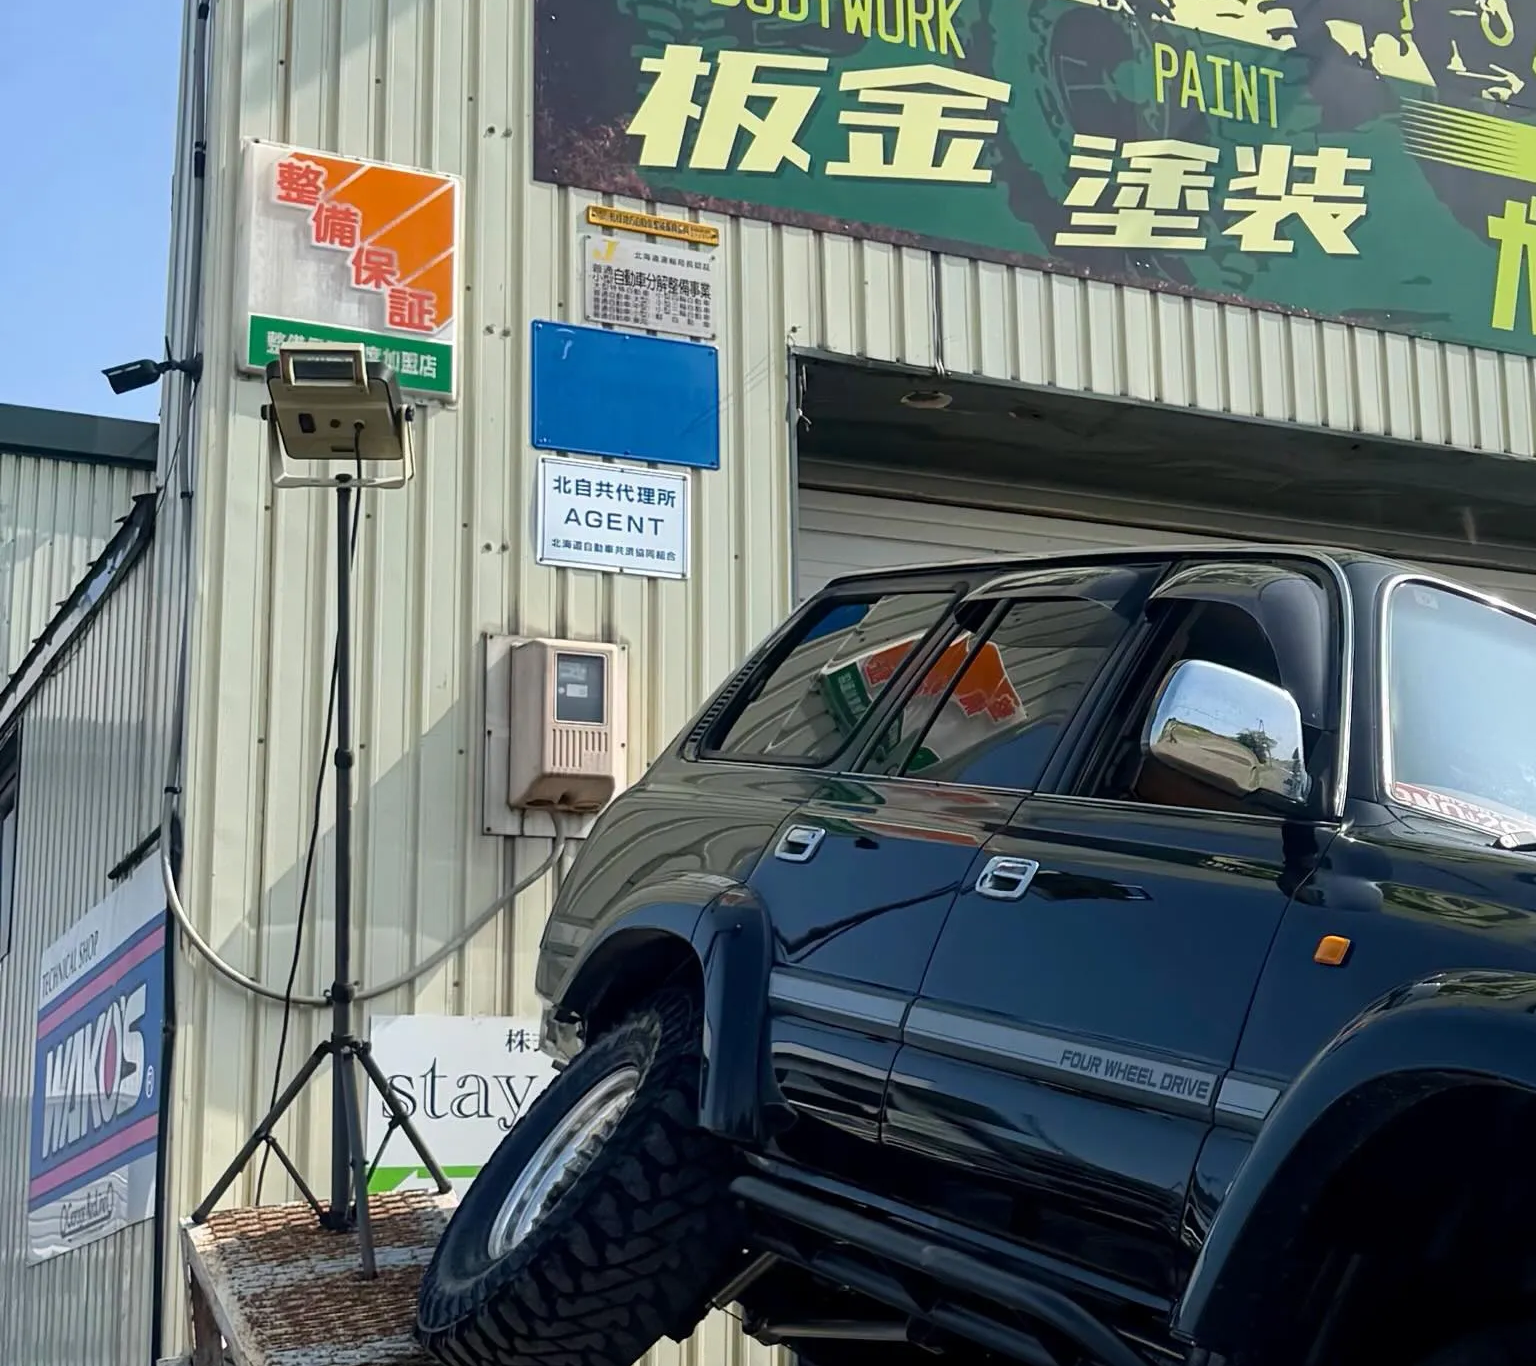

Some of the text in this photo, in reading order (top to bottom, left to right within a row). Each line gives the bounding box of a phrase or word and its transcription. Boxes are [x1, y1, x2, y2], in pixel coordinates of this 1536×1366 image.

[626, 43, 1011, 183] 板金
[1154, 42, 1284, 128] PAINT
[1055, 133, 1372, 255] 塗装
[276, 161, 436, 333] 整備保証
[553, 475, 677, 508] 北自共代理所
[564, 507, 664, 536] AGENT
[42, 930, 99, 997] TECHNICAL SHOP
[42, 983, 147, 1160] WAKO'S
[1060, 1049, 1210, 1100] FOUR WHEEL DRIVE
